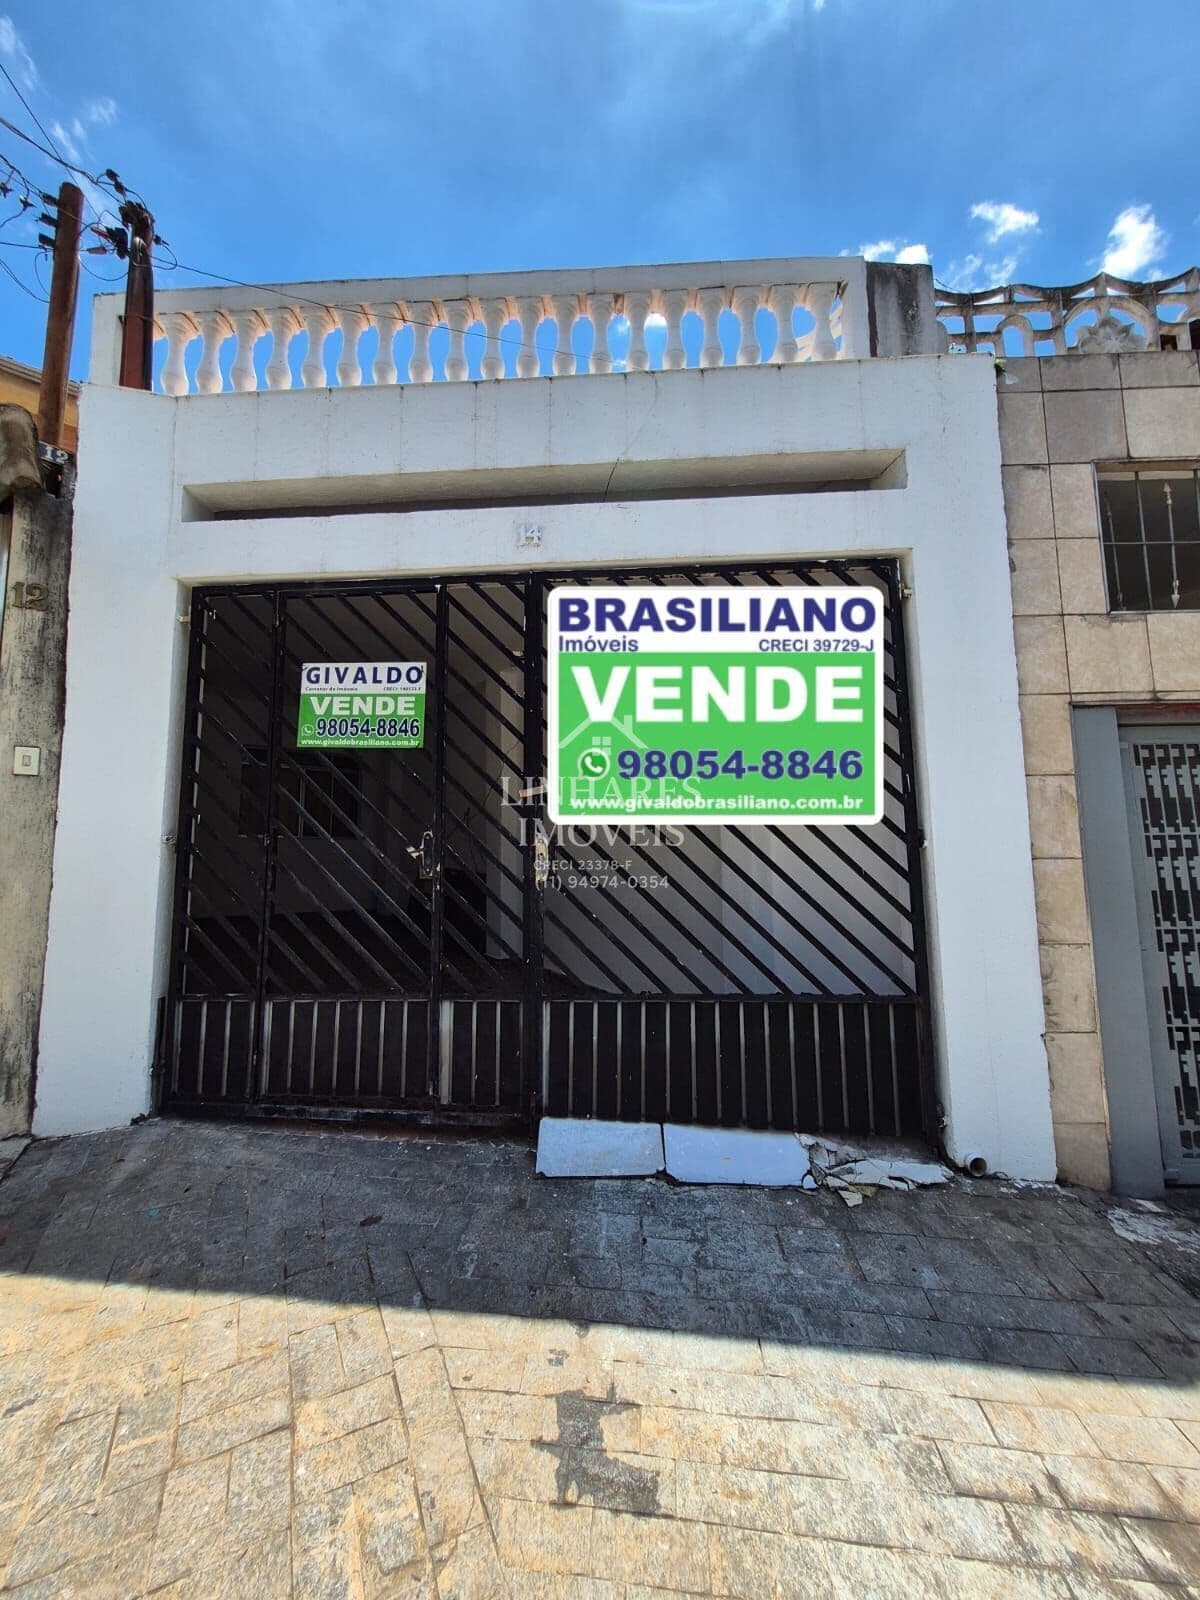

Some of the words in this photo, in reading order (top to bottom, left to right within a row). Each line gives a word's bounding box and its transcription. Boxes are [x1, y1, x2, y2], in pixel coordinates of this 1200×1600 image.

[45, 446, 69, 465] 12
[12, 581, 49, 612] 12
[306, 666, 423, 684] GIVALDO
[310, 697, 416, 716] VENDE
[316, 718, 420, 737] 98054-8846
[301, 738, 420, 747] www.givaldobrasiliano.com.br
